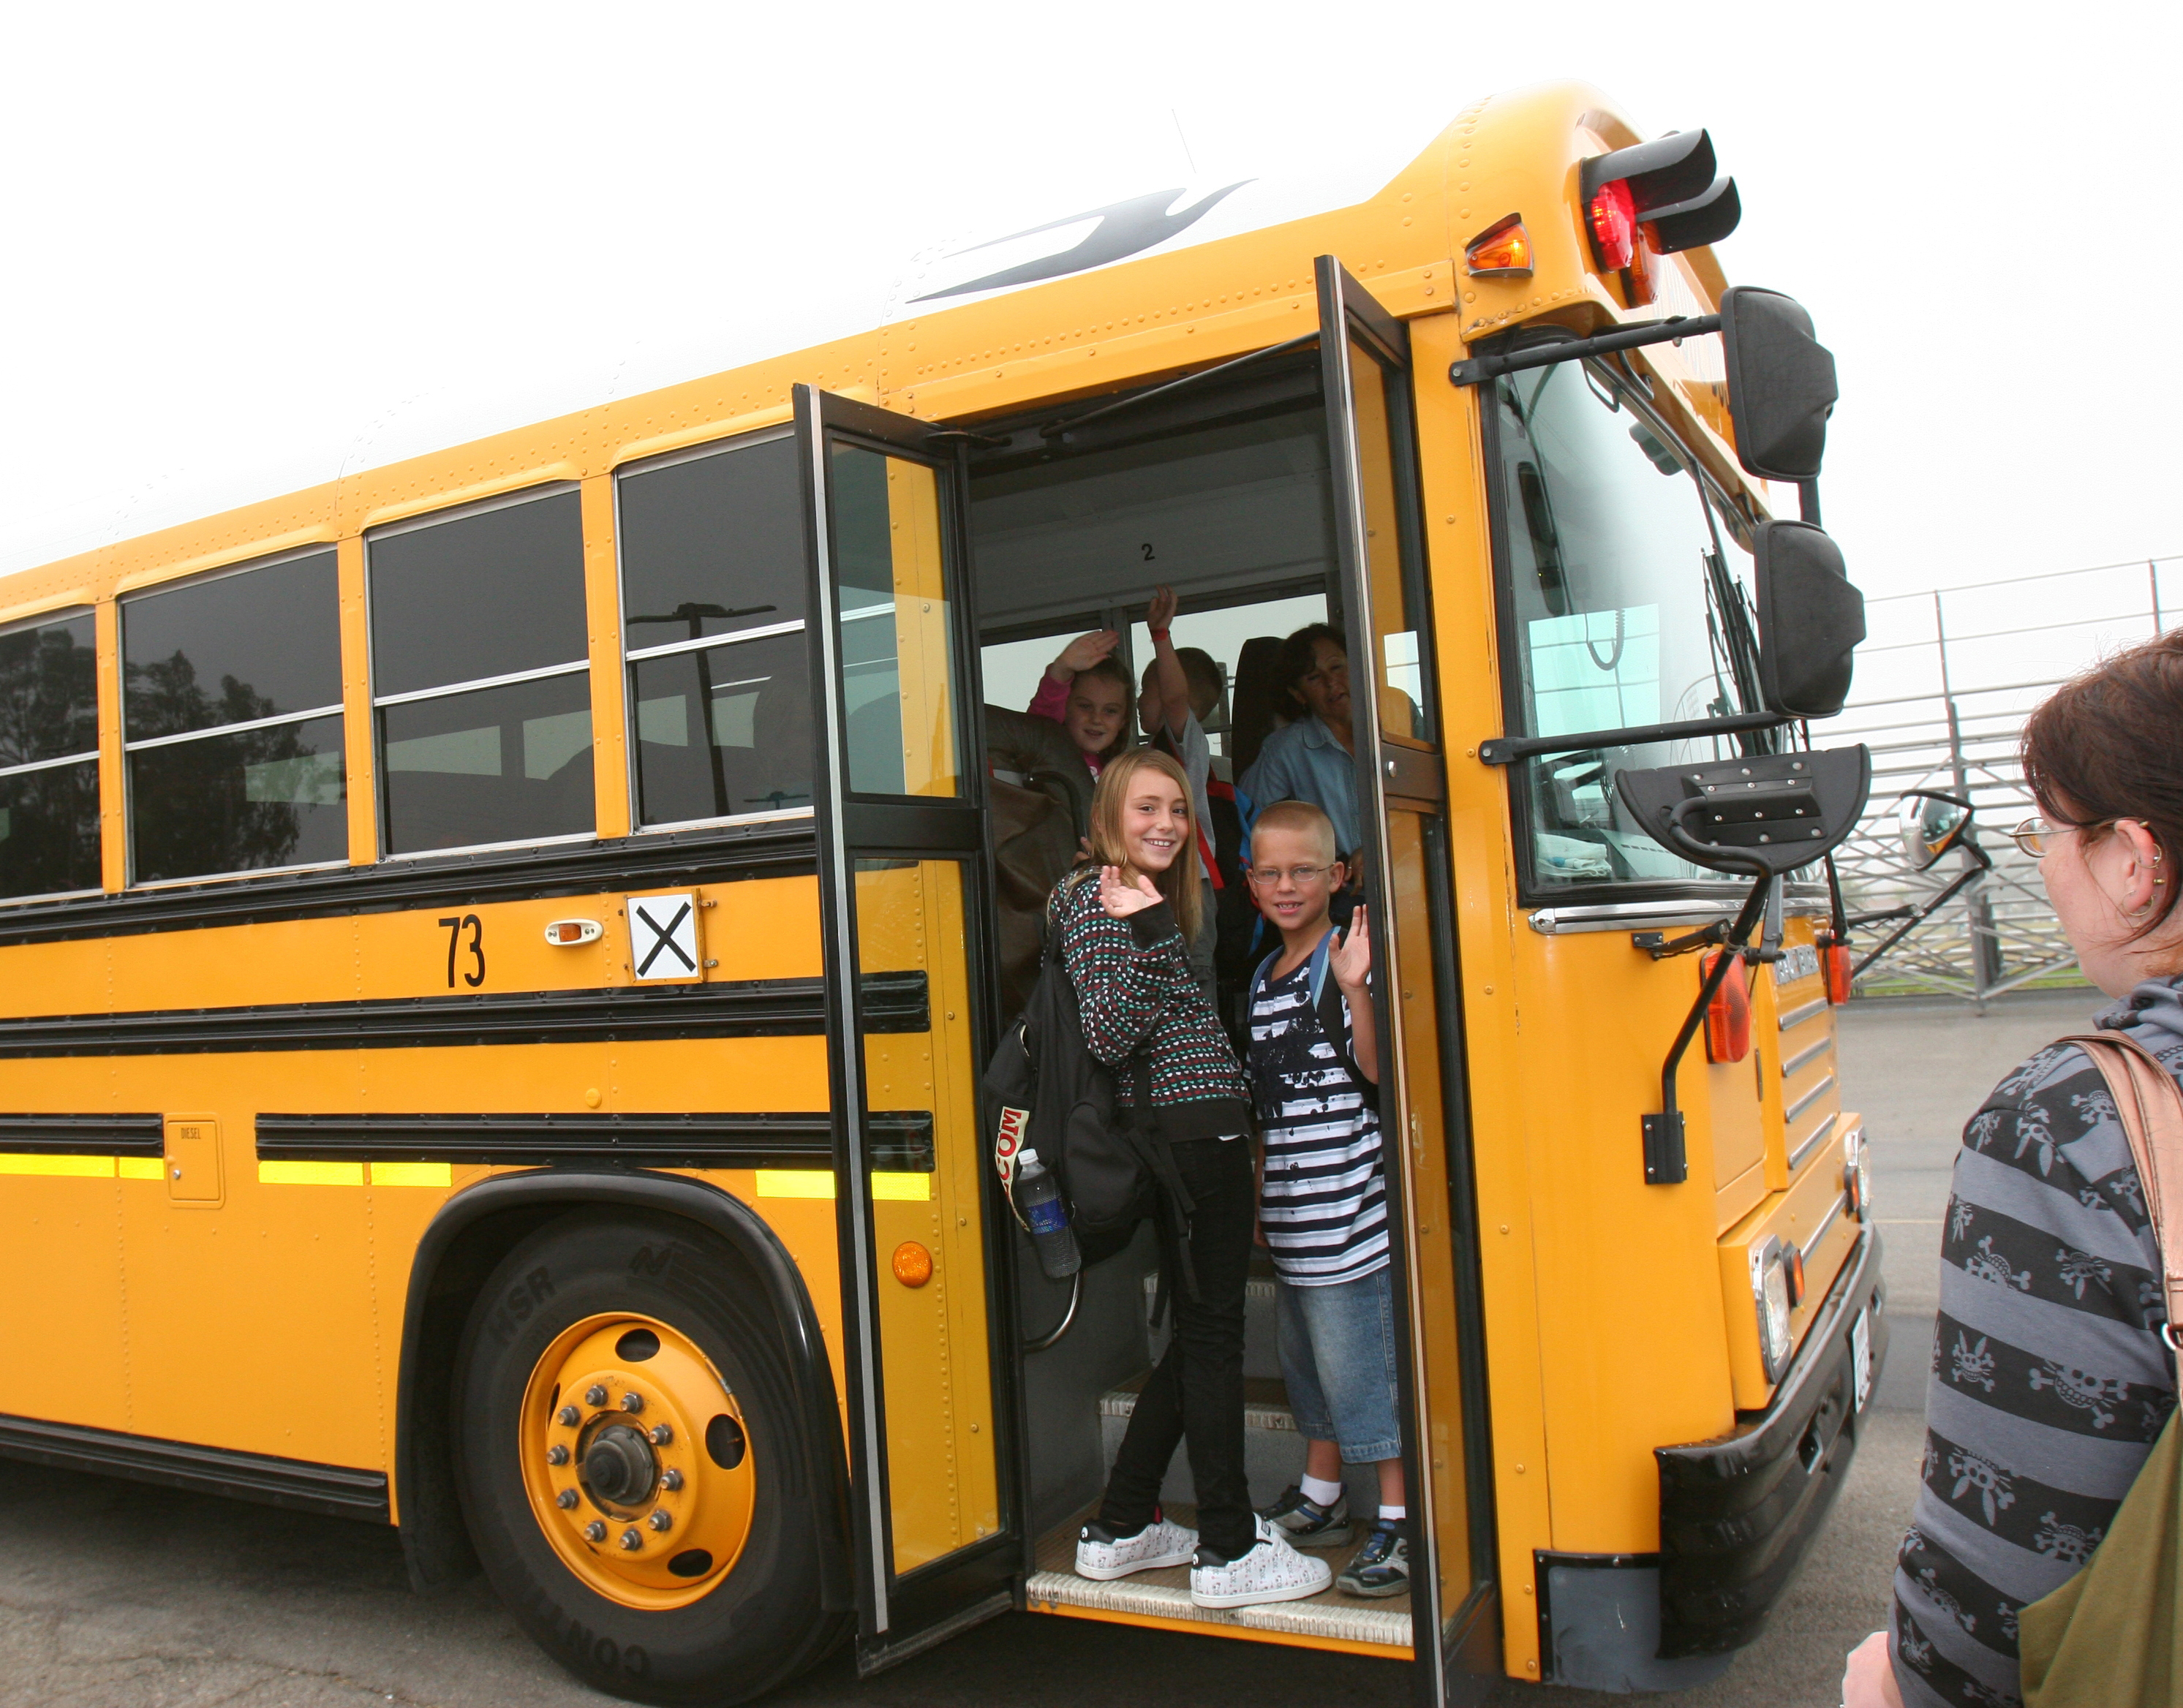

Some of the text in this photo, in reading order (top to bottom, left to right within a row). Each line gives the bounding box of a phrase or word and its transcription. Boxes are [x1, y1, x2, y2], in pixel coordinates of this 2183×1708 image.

[1141, 543, 1155, 561] 2
[438, 913, 486, 989] 73
[181, 1127, 201, 1139] DIESEL
